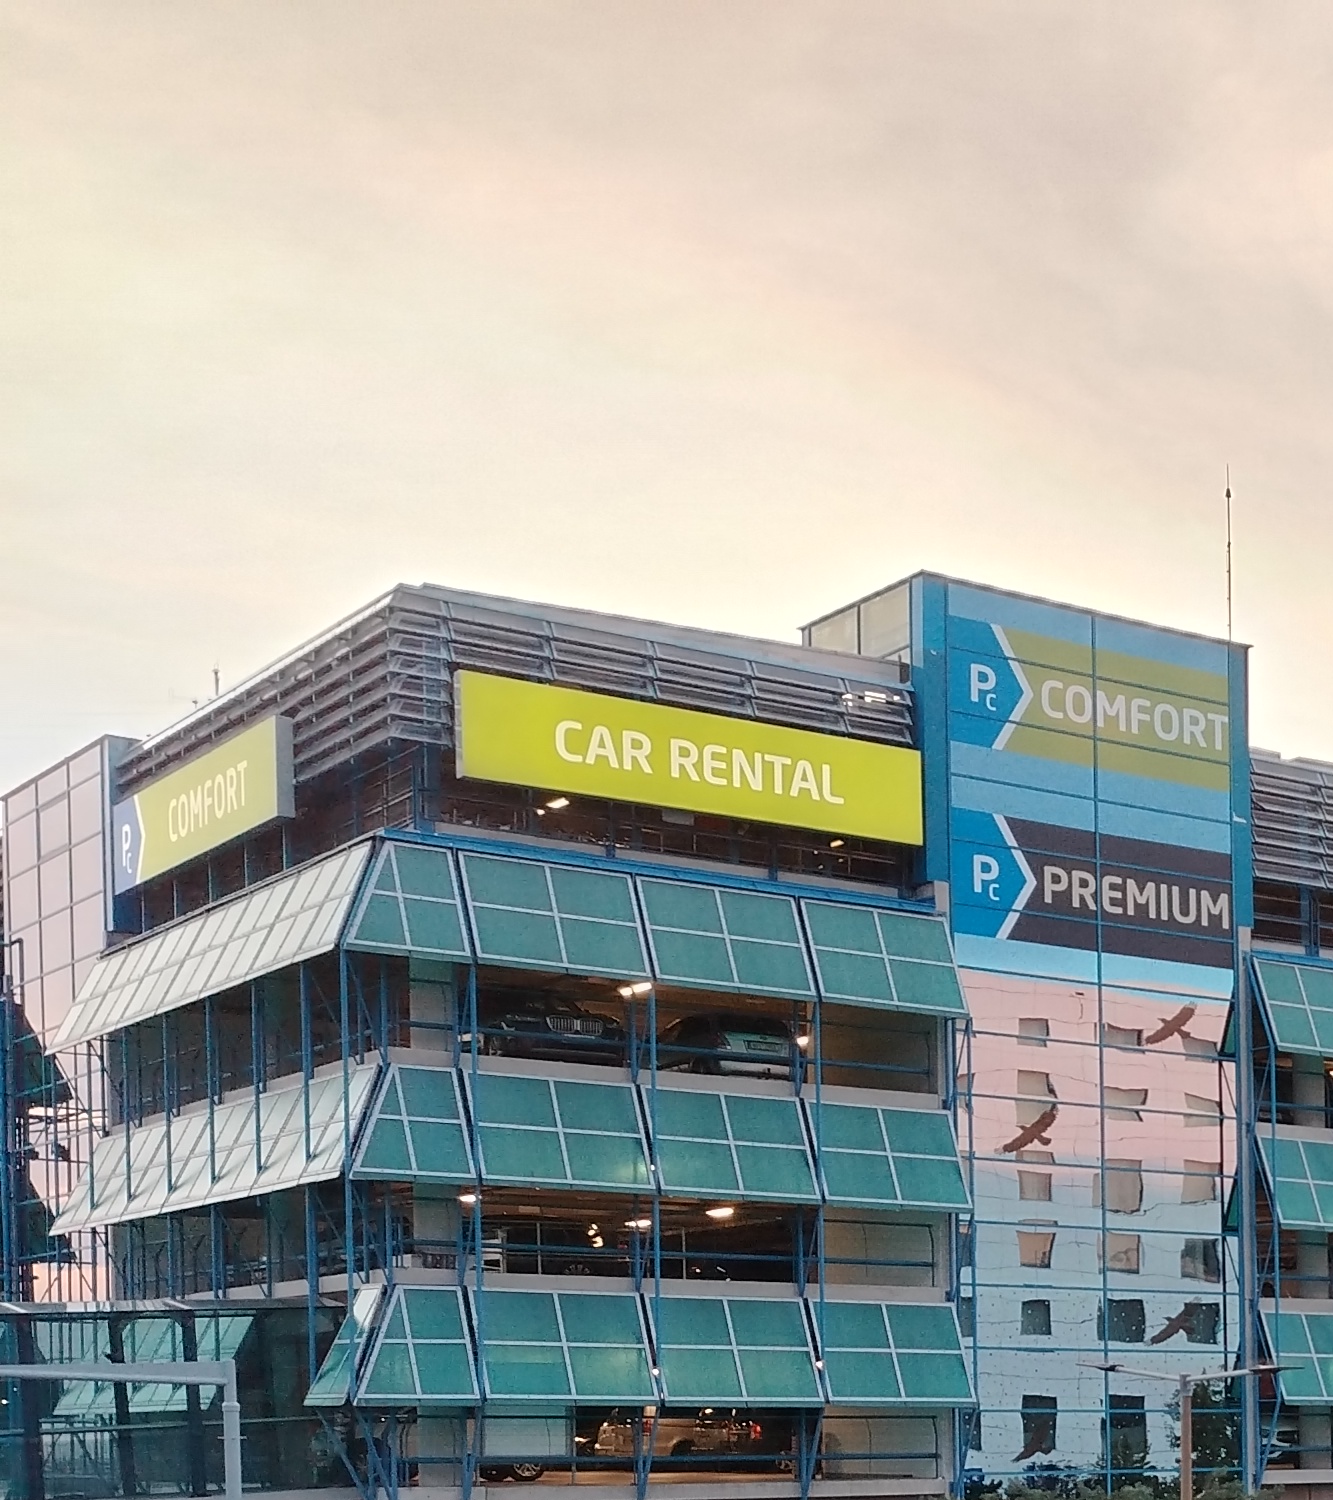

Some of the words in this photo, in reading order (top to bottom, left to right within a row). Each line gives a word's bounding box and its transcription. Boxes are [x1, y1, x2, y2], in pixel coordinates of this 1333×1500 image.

[1041, 679, 1229, 751] COMFORT
[167, 759, 248, 843] COMFORT
[554, 719, 653, 774] CAR
[669, 737, 845, 805] RENTAL
[1043, 865, 1230, 930] PREMIUM
